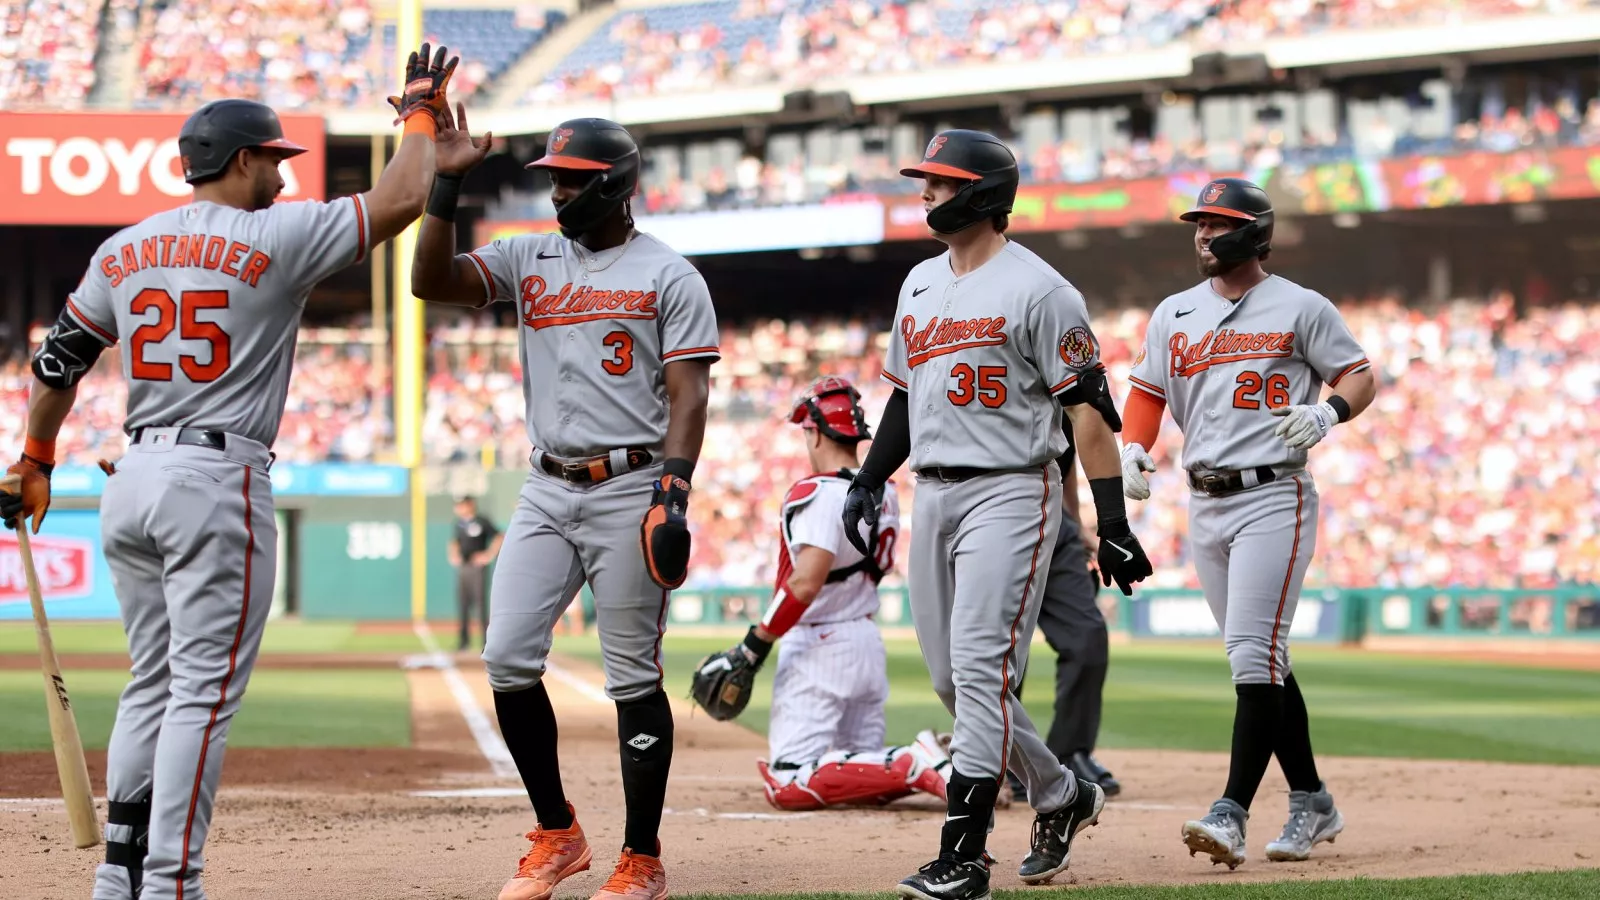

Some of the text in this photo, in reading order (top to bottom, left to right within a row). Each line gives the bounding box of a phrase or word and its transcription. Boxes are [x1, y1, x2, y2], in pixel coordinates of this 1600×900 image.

[100, 234, 271, 288] SANTANDER
[520, 274, 659, 332] Baltimore
[130, 287, 231, 383] 25
[601, 331, 633, 376] 3
[901, 314, 1008, 371] Baltimore
[1169, 328, 1295, 380] Baltimore
[947, 362, 1008, 409] 35
[1232, 370, 1290, 410] 26
[630, 454, 639, 464] 3
